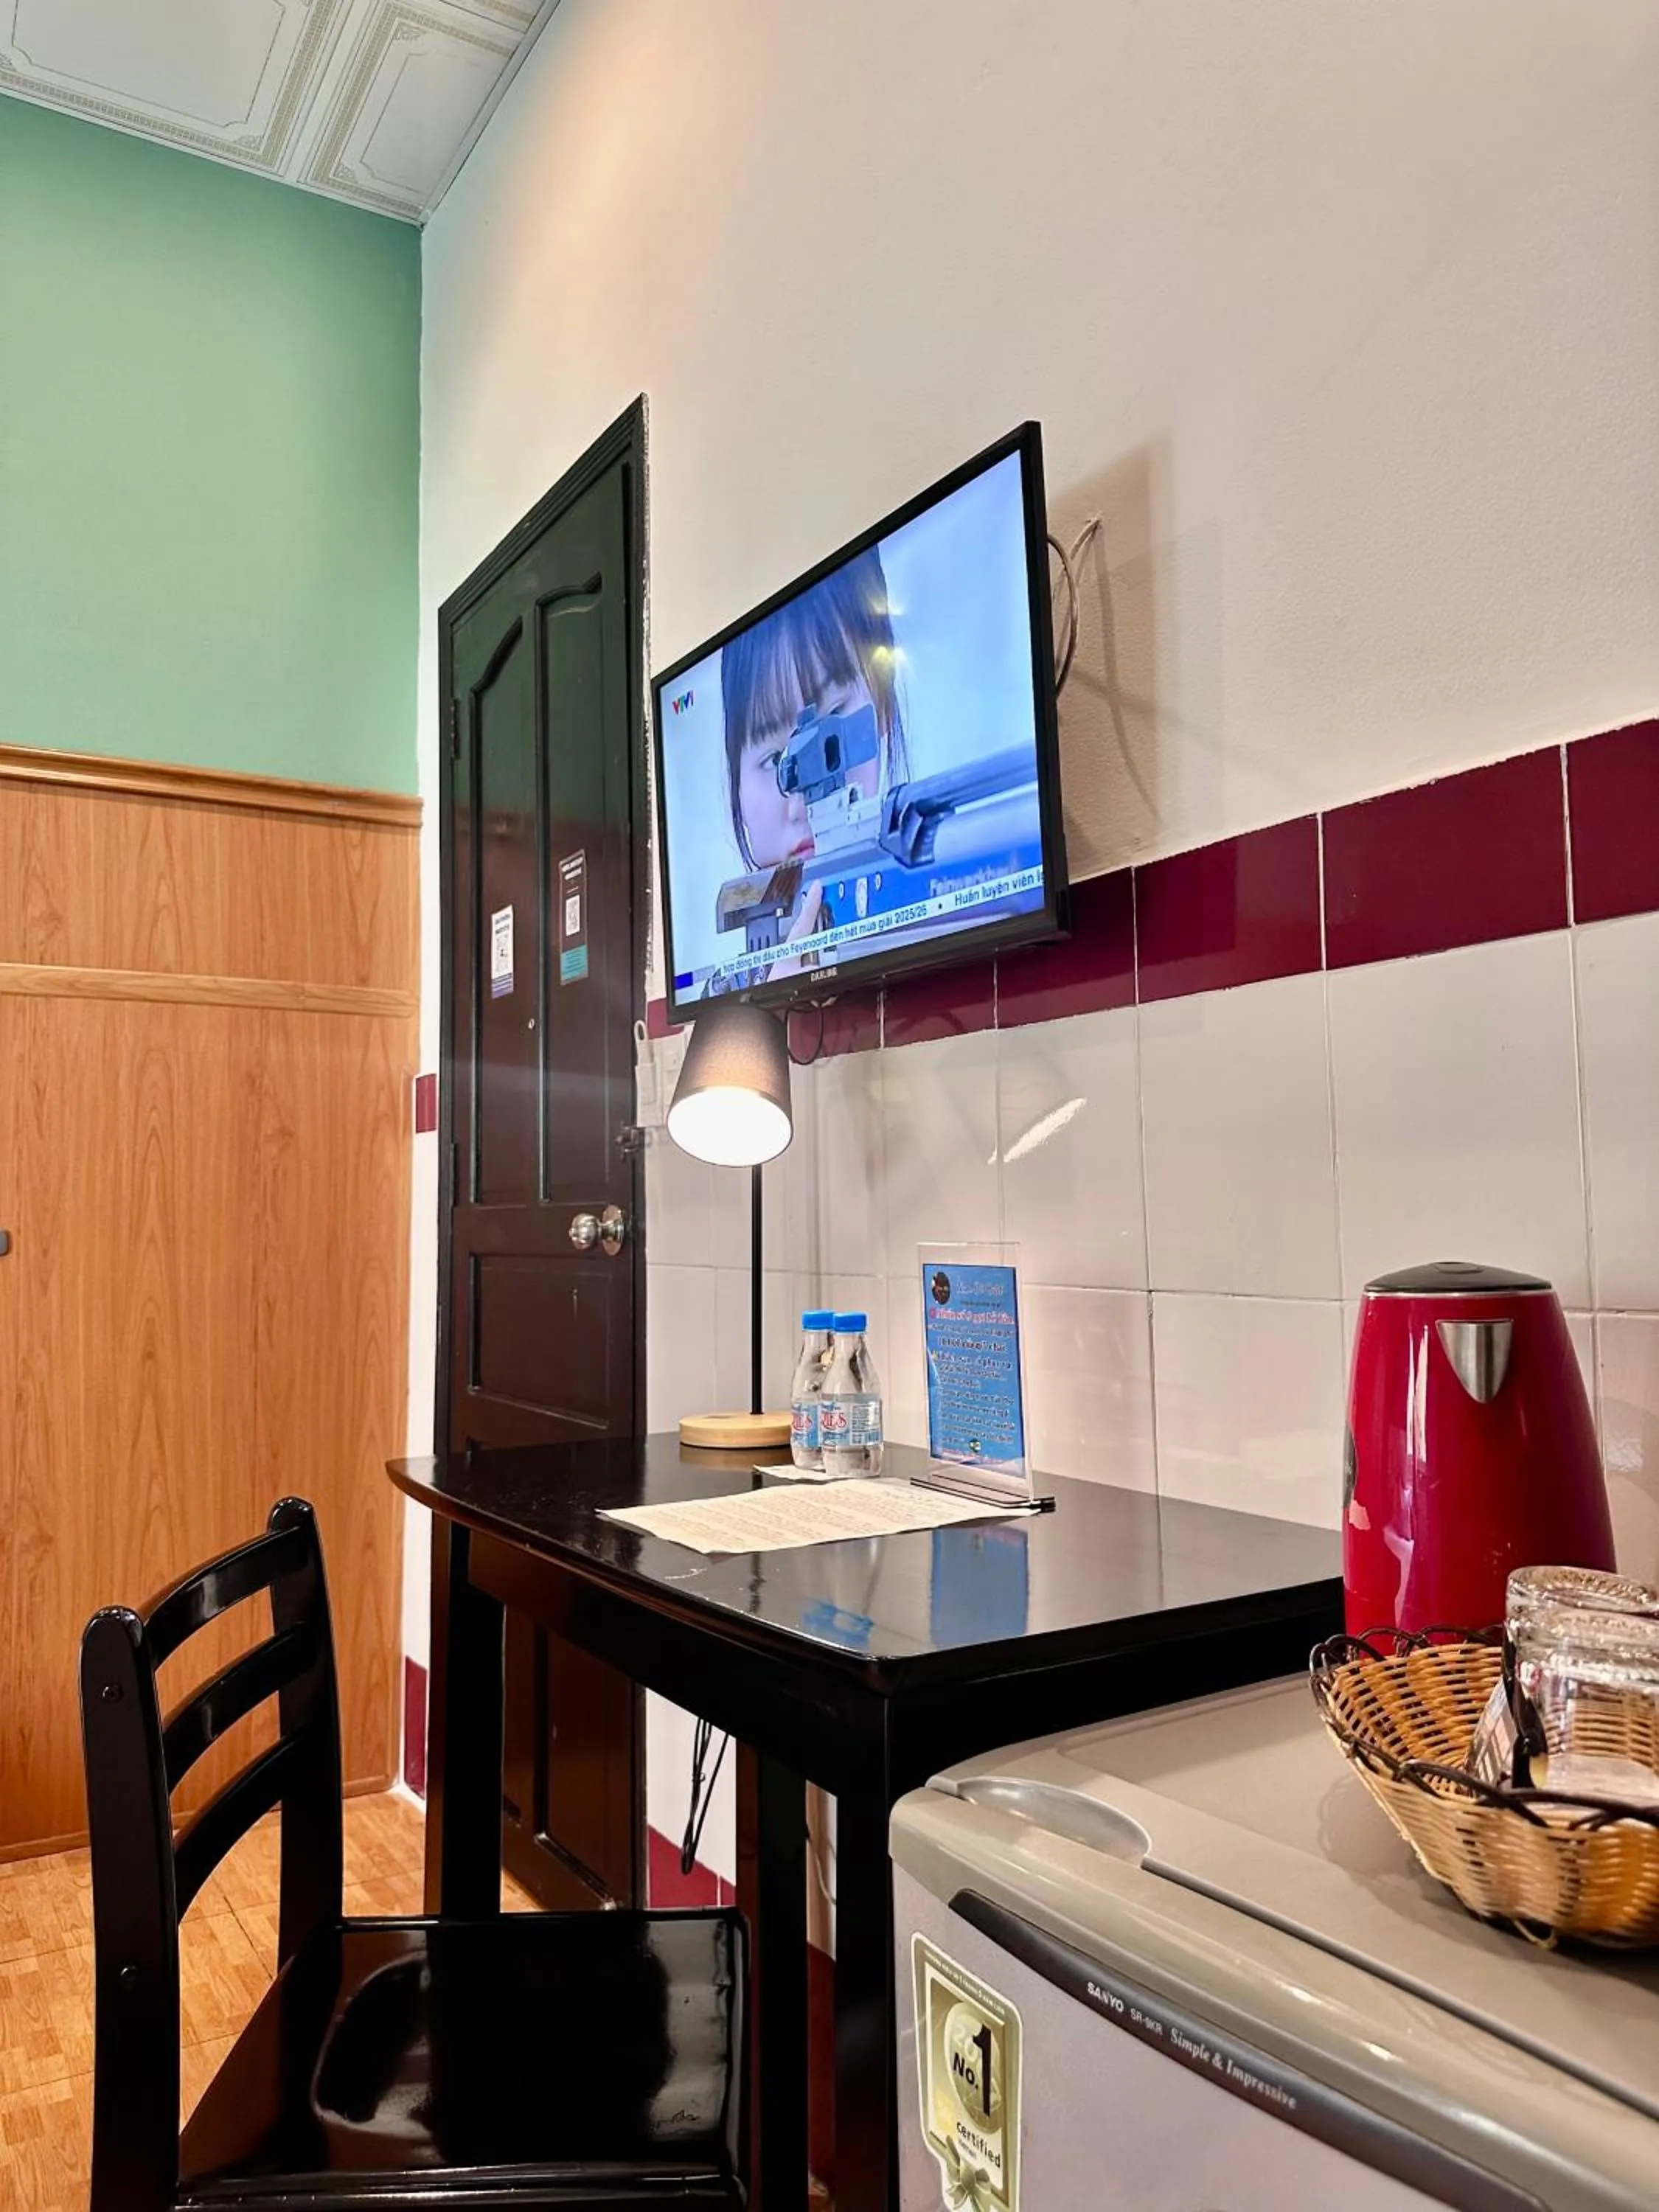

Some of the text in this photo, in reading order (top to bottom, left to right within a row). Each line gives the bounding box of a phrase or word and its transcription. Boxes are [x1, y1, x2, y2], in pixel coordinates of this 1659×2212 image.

[955, 889, 980, 906] Huấn
[1012, 873, 1034, 889] viên
[1087, 1981, 1124, 2013] SANYO
[1170, 2027, 1210, 2062] Simple
[1211, 2052, 1223, 2072] &
[1226, 2059, 1297, 2110] Impressive
[956, 2121, 1001, 2168] certified
